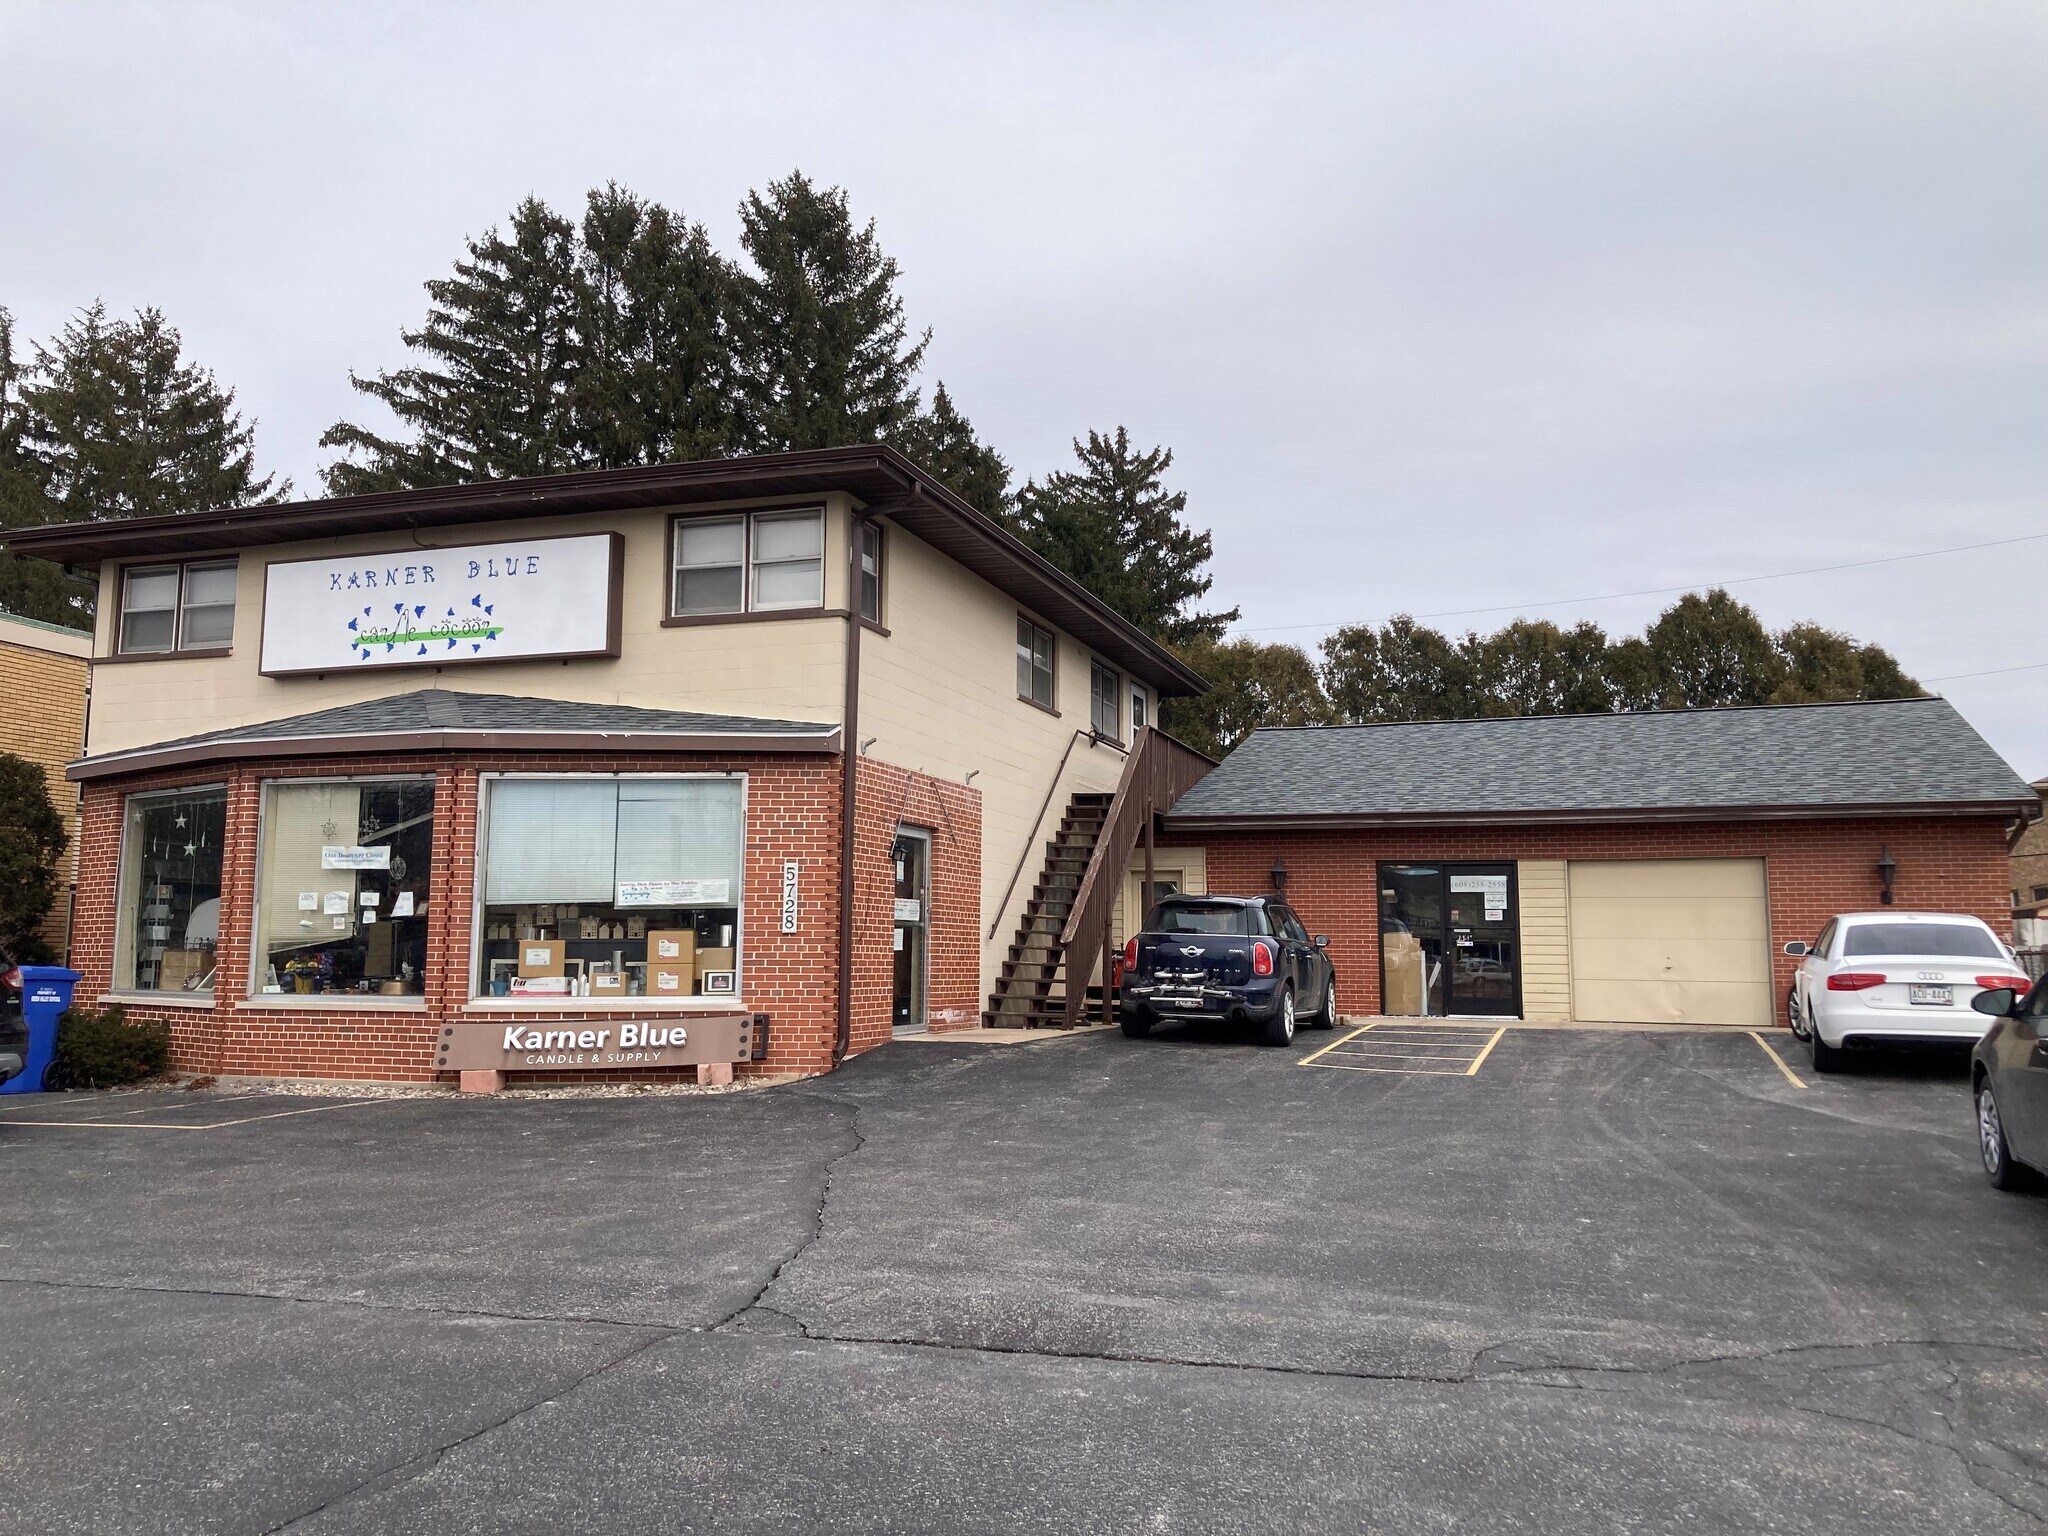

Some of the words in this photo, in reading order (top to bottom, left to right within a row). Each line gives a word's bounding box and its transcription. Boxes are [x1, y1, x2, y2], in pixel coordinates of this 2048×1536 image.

[330, 565, 435, 590] KARNER
[467, 556, 540, 579] BLUE
[360, 608, 417, 645] candle
[785, 867, 796, 929] 5728
[502, 1026, 611, 1051] Karner
[619, 1022, 688, 1048] Blue
[526, 1054, 584, 1064] CANDLE
[591, 1053, 600, 1063] &
[607, 1052, 662, 1063] SUPPLY
